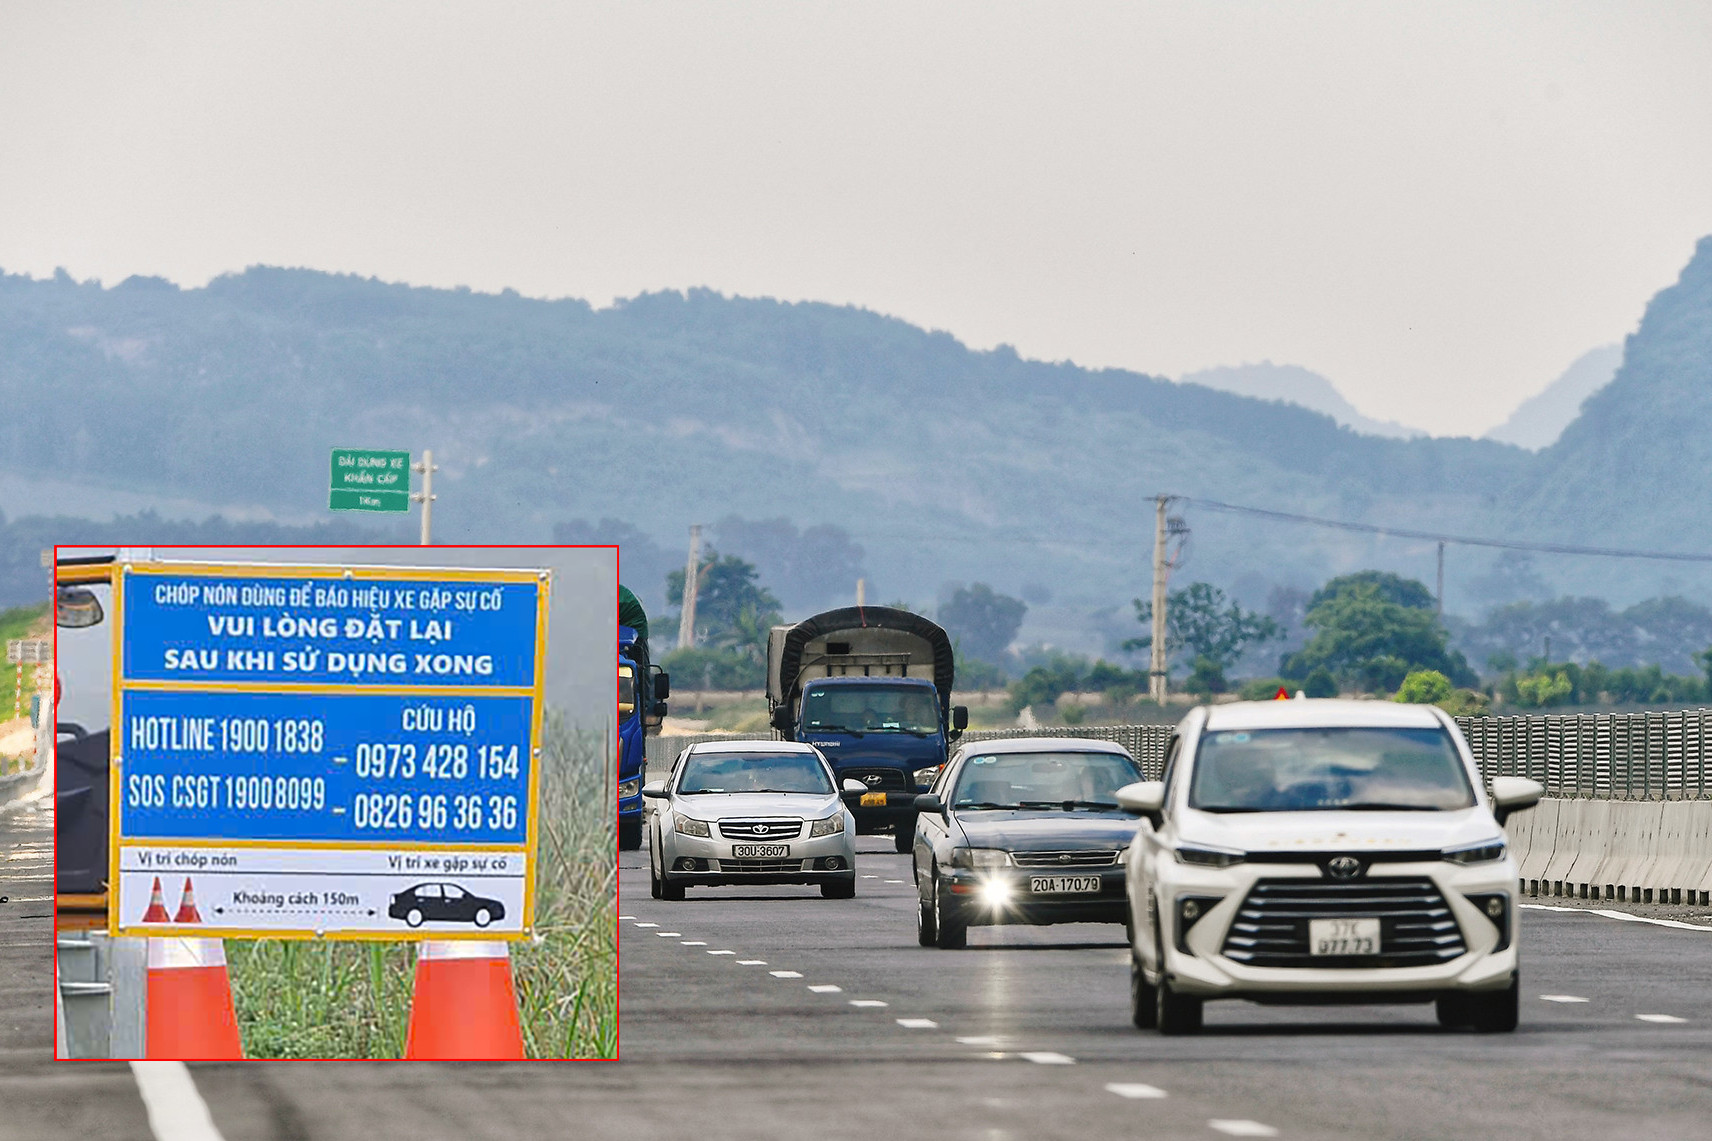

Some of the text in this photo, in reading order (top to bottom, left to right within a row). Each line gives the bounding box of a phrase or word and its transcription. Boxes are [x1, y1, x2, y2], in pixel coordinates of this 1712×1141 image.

[155, 581, 504, 614] CHÓP NÓN DÙNG ĐỂ BÁO HIỆU XE GẶP SỰ CỐ
[208, 612, 452, 645] VUI LÒNG ĐẶT LẠI
[164, 645, 493, 678] SAU KHI SỬ DỤNG XONG
[132, 717, 324, 754] HOTLINE 1900 1838
[402, 704, 476, 736] CỨU HỘ
[356, 744, 416, 778] 0973
[422, 745, 467, 779] 428
[477, 746, 519, 780] 154
[128, 775, 165, 807] SOS
[172, 775, 220, 808] CSGT
[354, 794, 412, 828] 0826
[419, 796, 447, 830] 96
[454, 796, 482, 830] 36
[488, 796, 517, 830] 36
[138, 852, 237, 868] Vị trí chóp nón
[388, 856, 507, 872] Vị trí xe gặp sự cố
[233, 891, 359, 908] Khoảng cách 150m
